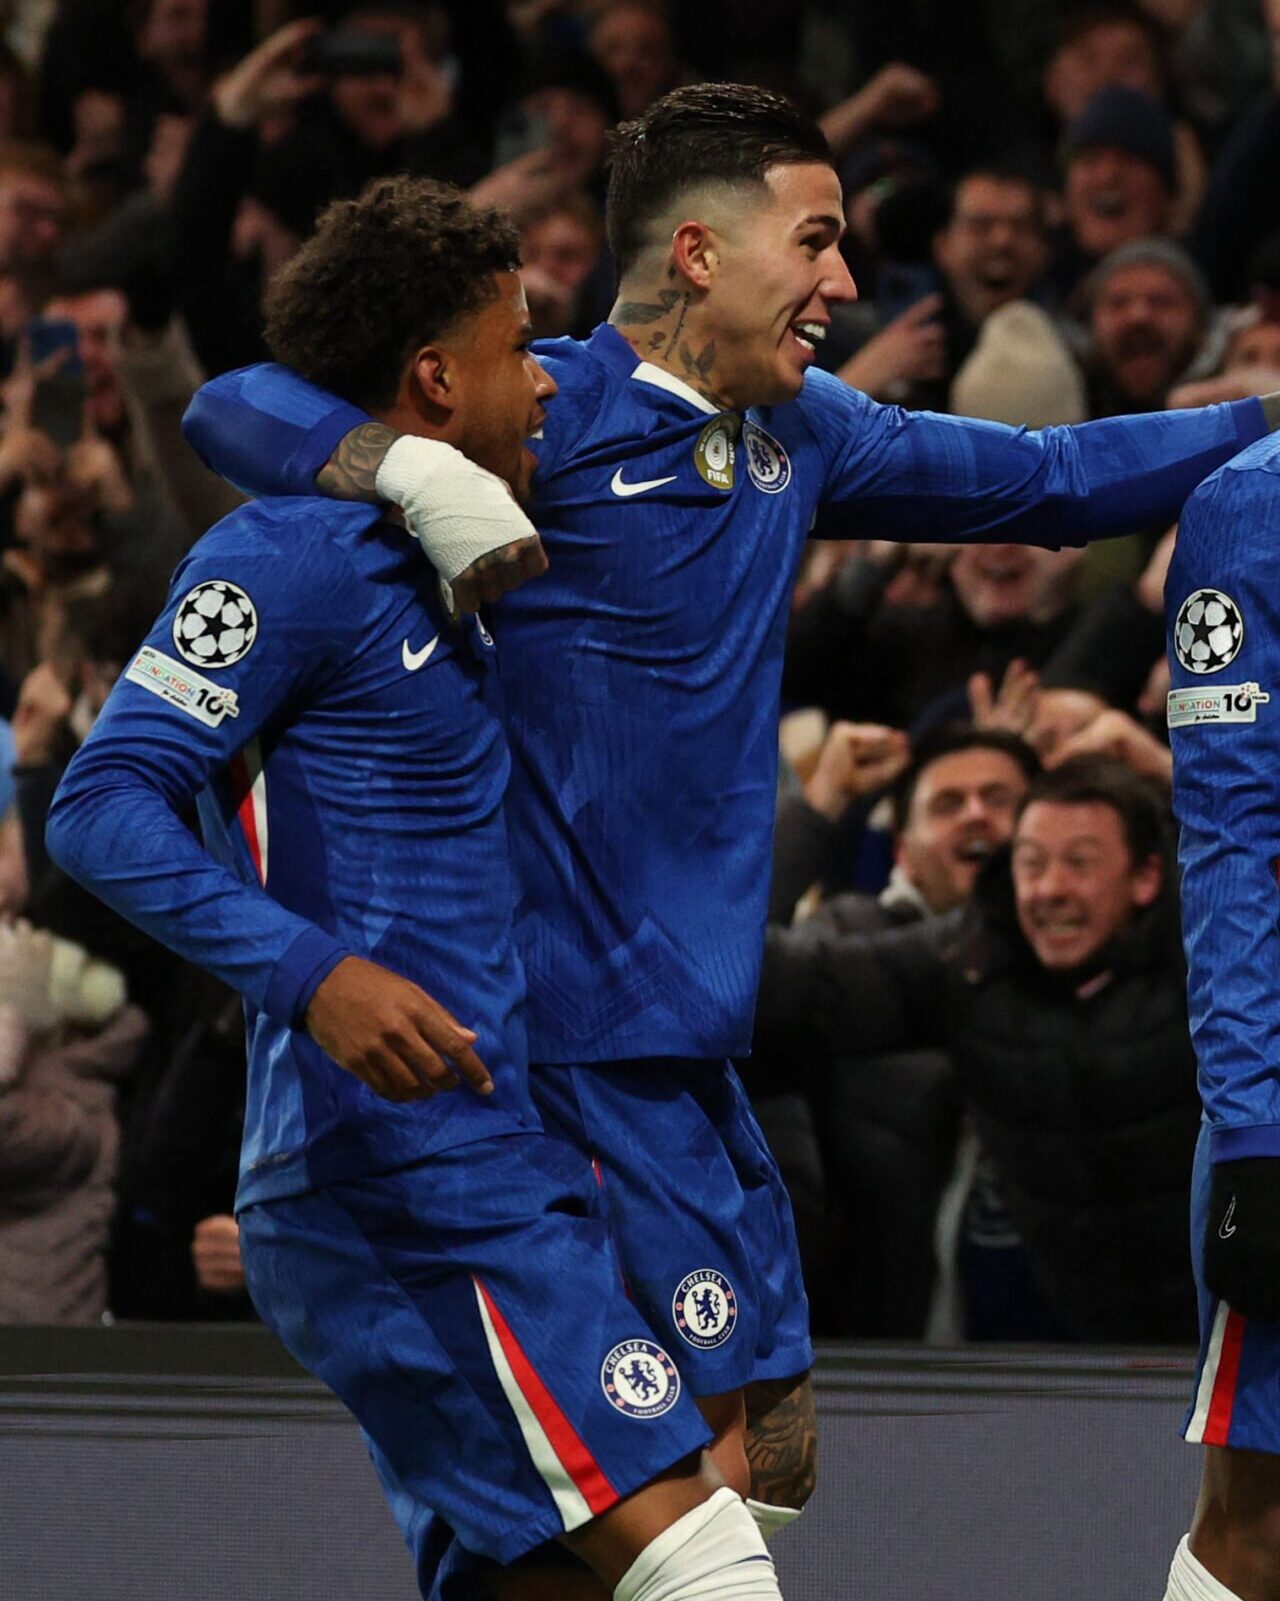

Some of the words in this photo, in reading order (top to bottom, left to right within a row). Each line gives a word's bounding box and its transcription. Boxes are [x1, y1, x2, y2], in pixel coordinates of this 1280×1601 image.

[707, 469, 729, 484] FIFA
[196, 688, 225, 715] 10
[1223, 693, 1252, 712] 10
[681, 1272, 722, 1293] CHELSEA
[606, 1342, 648, 1373] CHELSEA
